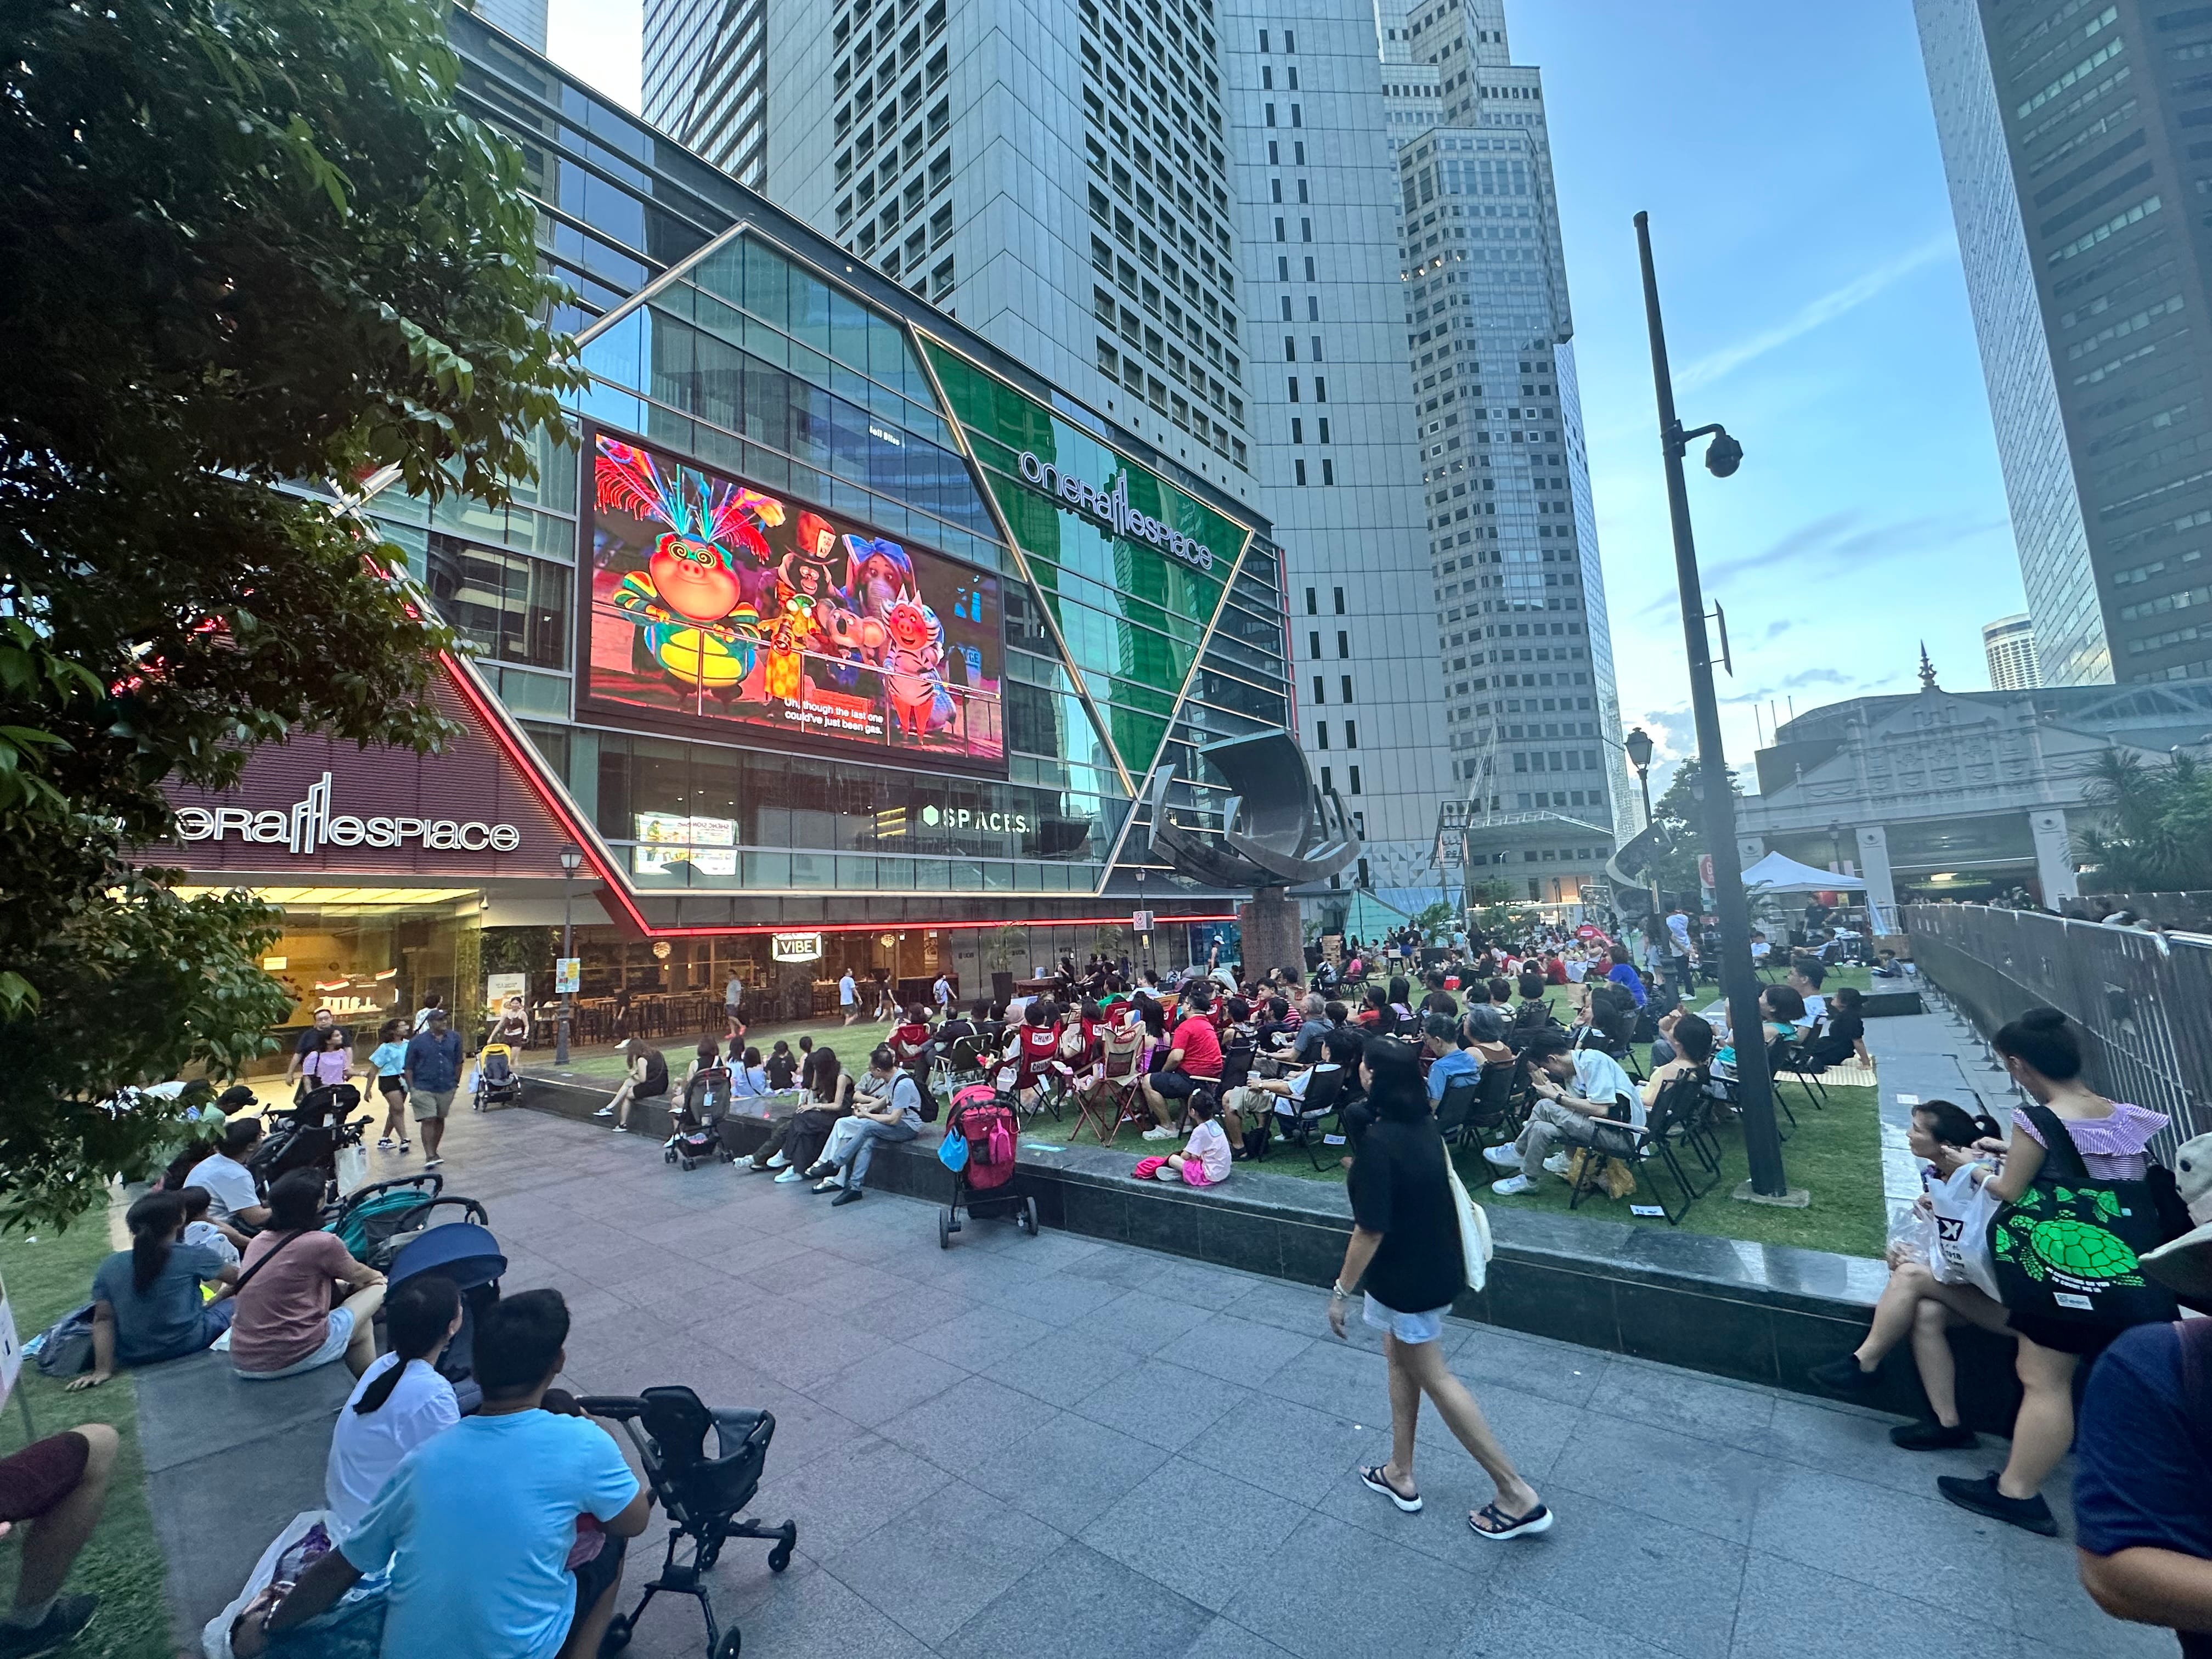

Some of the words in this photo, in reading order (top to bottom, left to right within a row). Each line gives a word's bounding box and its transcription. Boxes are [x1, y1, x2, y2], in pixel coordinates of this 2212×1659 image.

[785, 697, 801, 709] Uh,
[803, 701, 834, 715] though
[835, 707, 849, 717] the
[851, 709, 866, 720] last
[868, 714, 884, 723] one
[785, 710, 823, 724] could've
[824, 716, 840, 727] just
[842, 720, 864, 731] been
[865, 725, 883, 735] gas.
[781, 940, 813, 953] VIBE
[1034, 1034, 1052, 1042] CHUMS
